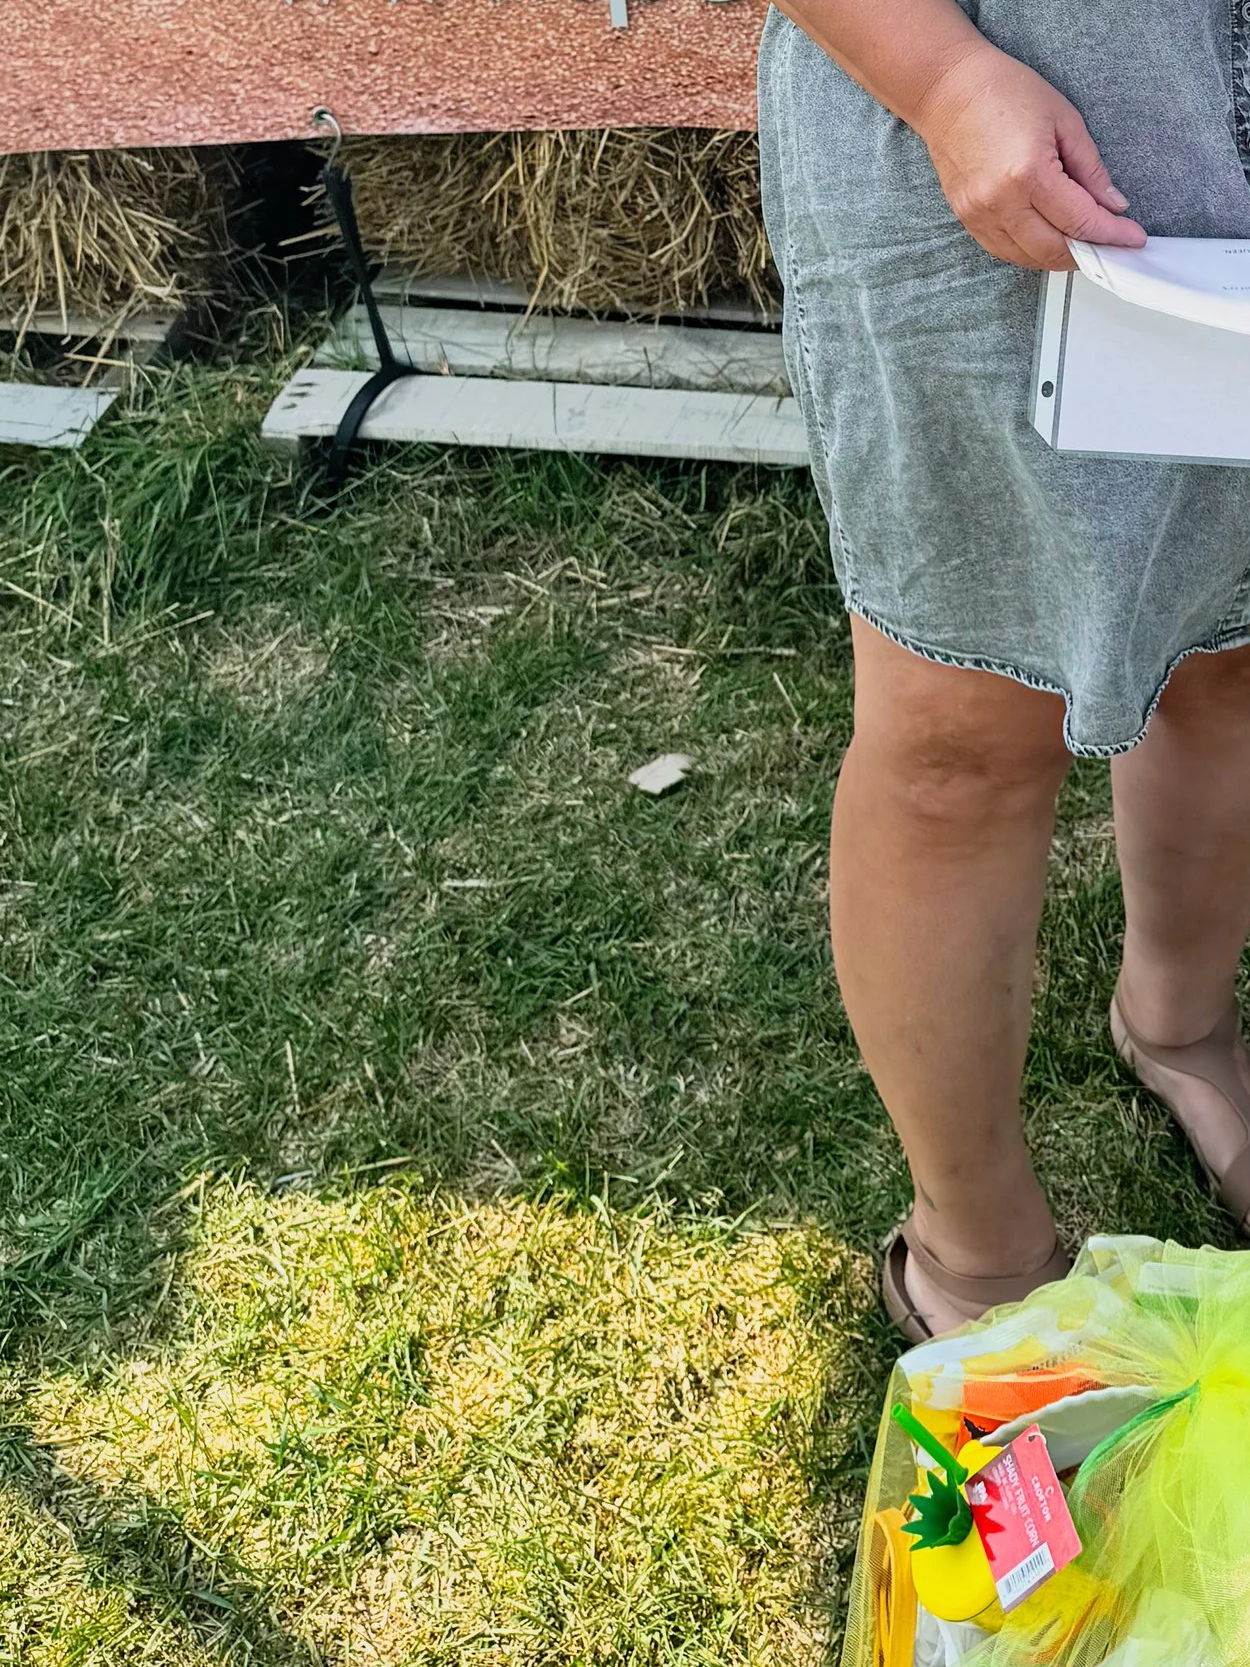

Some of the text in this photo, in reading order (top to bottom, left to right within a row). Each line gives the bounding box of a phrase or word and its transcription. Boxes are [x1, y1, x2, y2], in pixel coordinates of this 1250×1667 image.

[1002, 1453, 1020, 1488] SHADY
[1014, 1487, 1031, 1518] FRUIT
[1031, 1475, 1052, 1523] CROFTON
